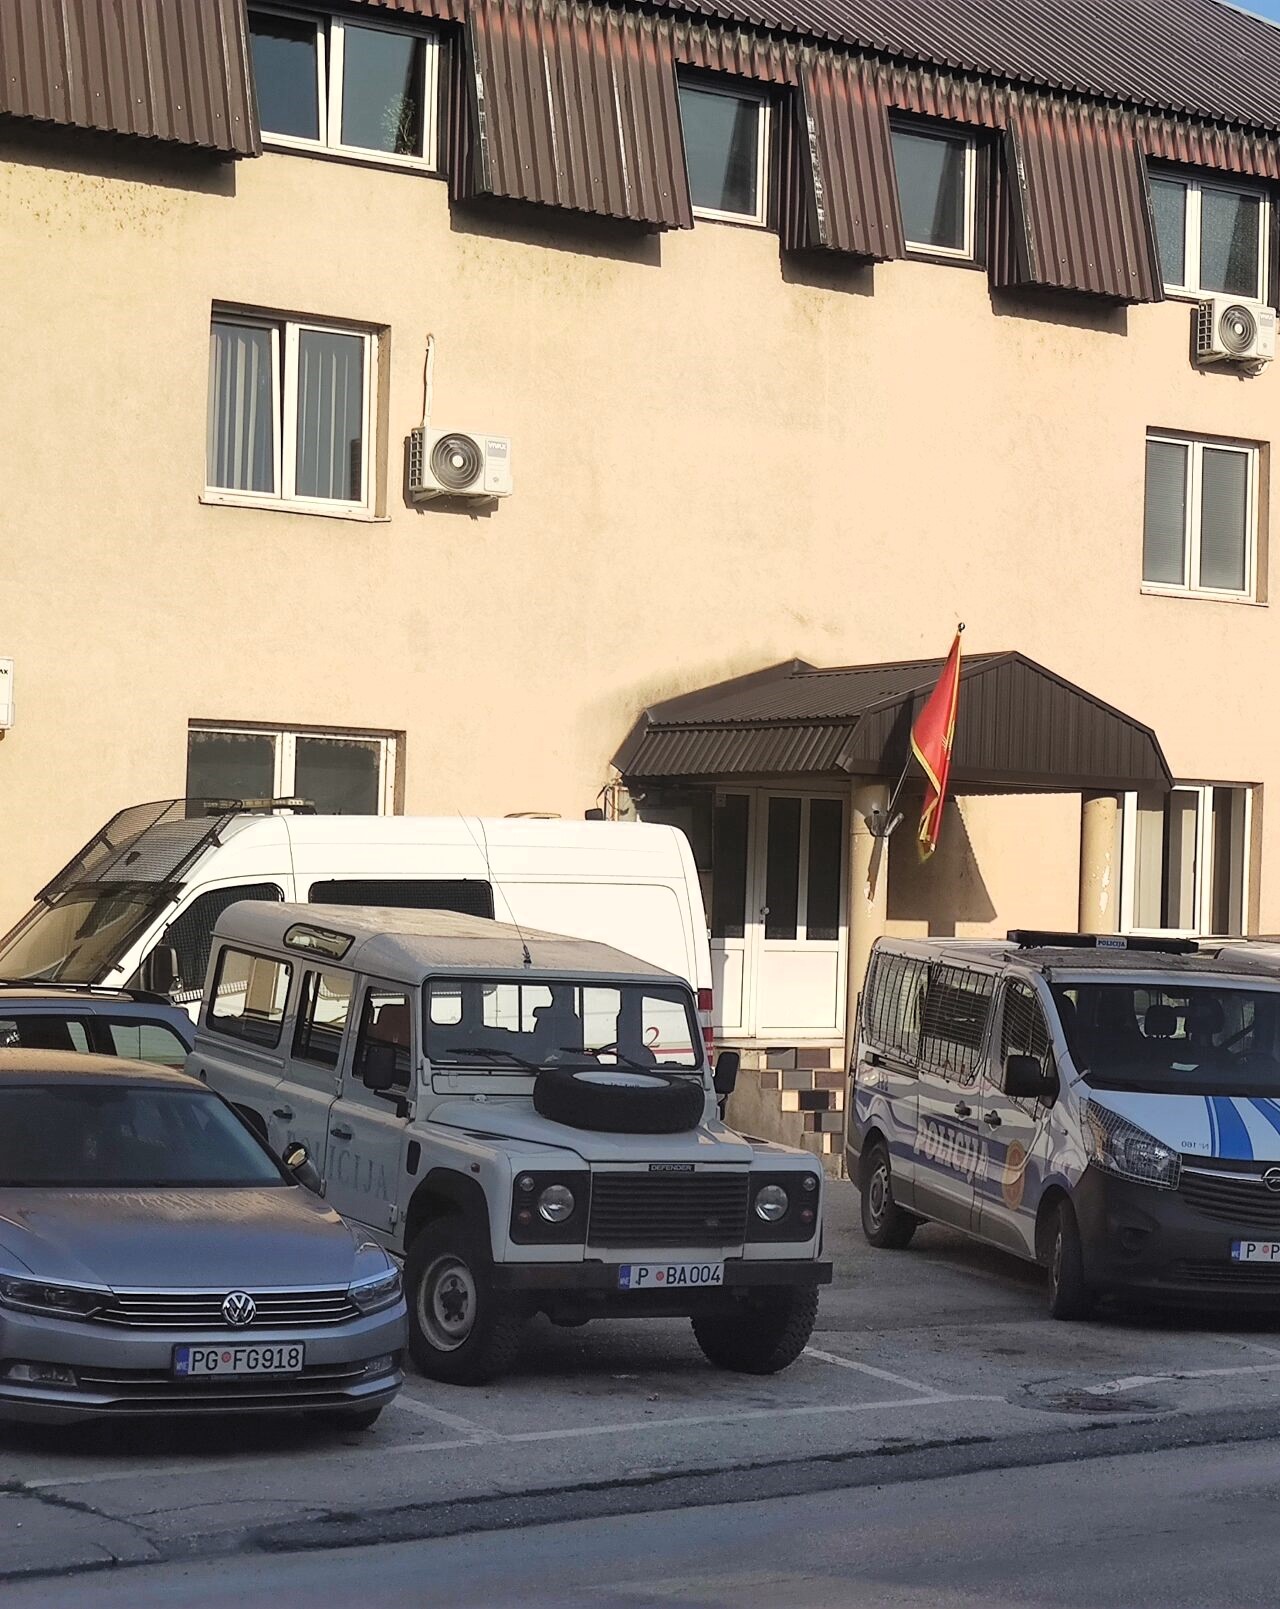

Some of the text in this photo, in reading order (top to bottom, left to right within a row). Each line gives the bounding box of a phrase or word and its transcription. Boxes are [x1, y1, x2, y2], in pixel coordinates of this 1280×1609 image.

[1097, 940, 1125, 948] POLICIJA
[1246, 1243, 1256, 1259] P
[638, 1267, 649, 1285] P
[666, 1265, 721, 1285] BA004
[192, 1350, 219, 1371] PG
[233, 1347, 300, 1370] FG918
